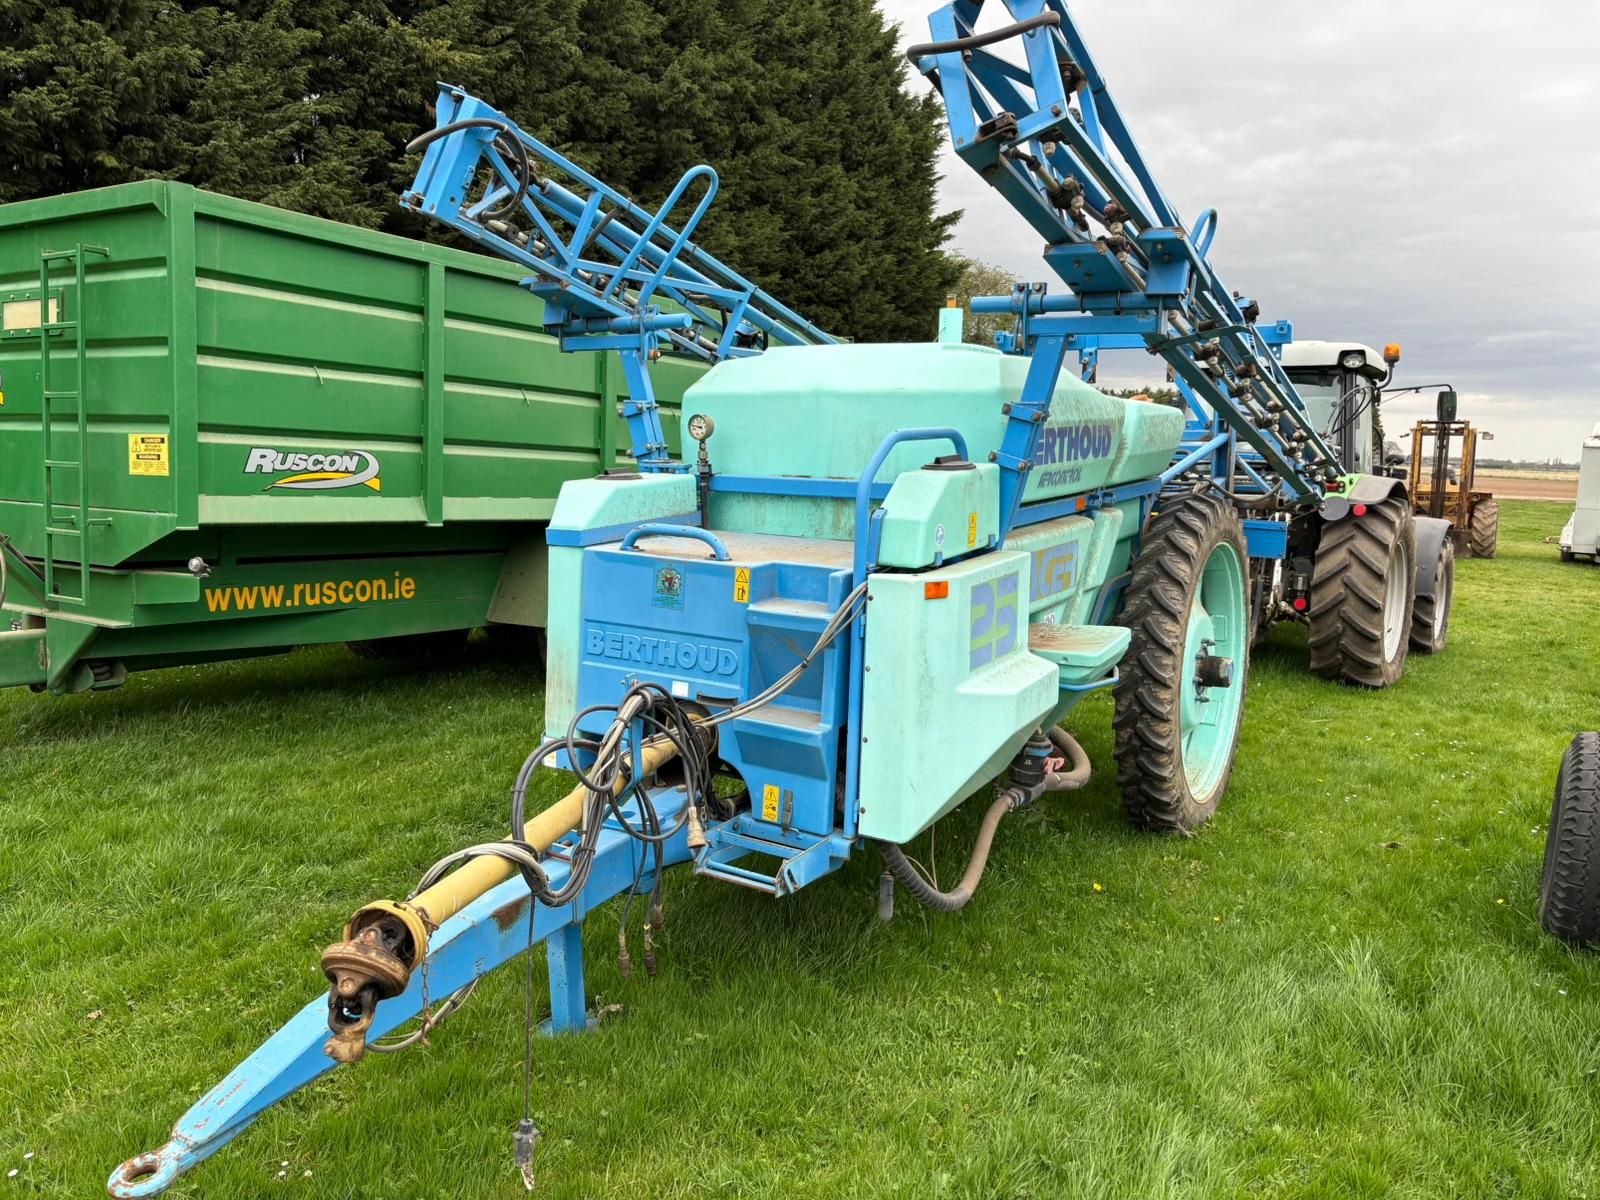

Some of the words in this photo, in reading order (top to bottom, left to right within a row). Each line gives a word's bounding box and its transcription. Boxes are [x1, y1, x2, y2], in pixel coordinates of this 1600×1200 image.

[243, 447, 360, 474] RUSCON
[1033, 424, 1112, 465] ERTHOUD
[205, 571, 416, 612] www.ruscon.ie
[587, 629, 739, 676] BERTHOUD
